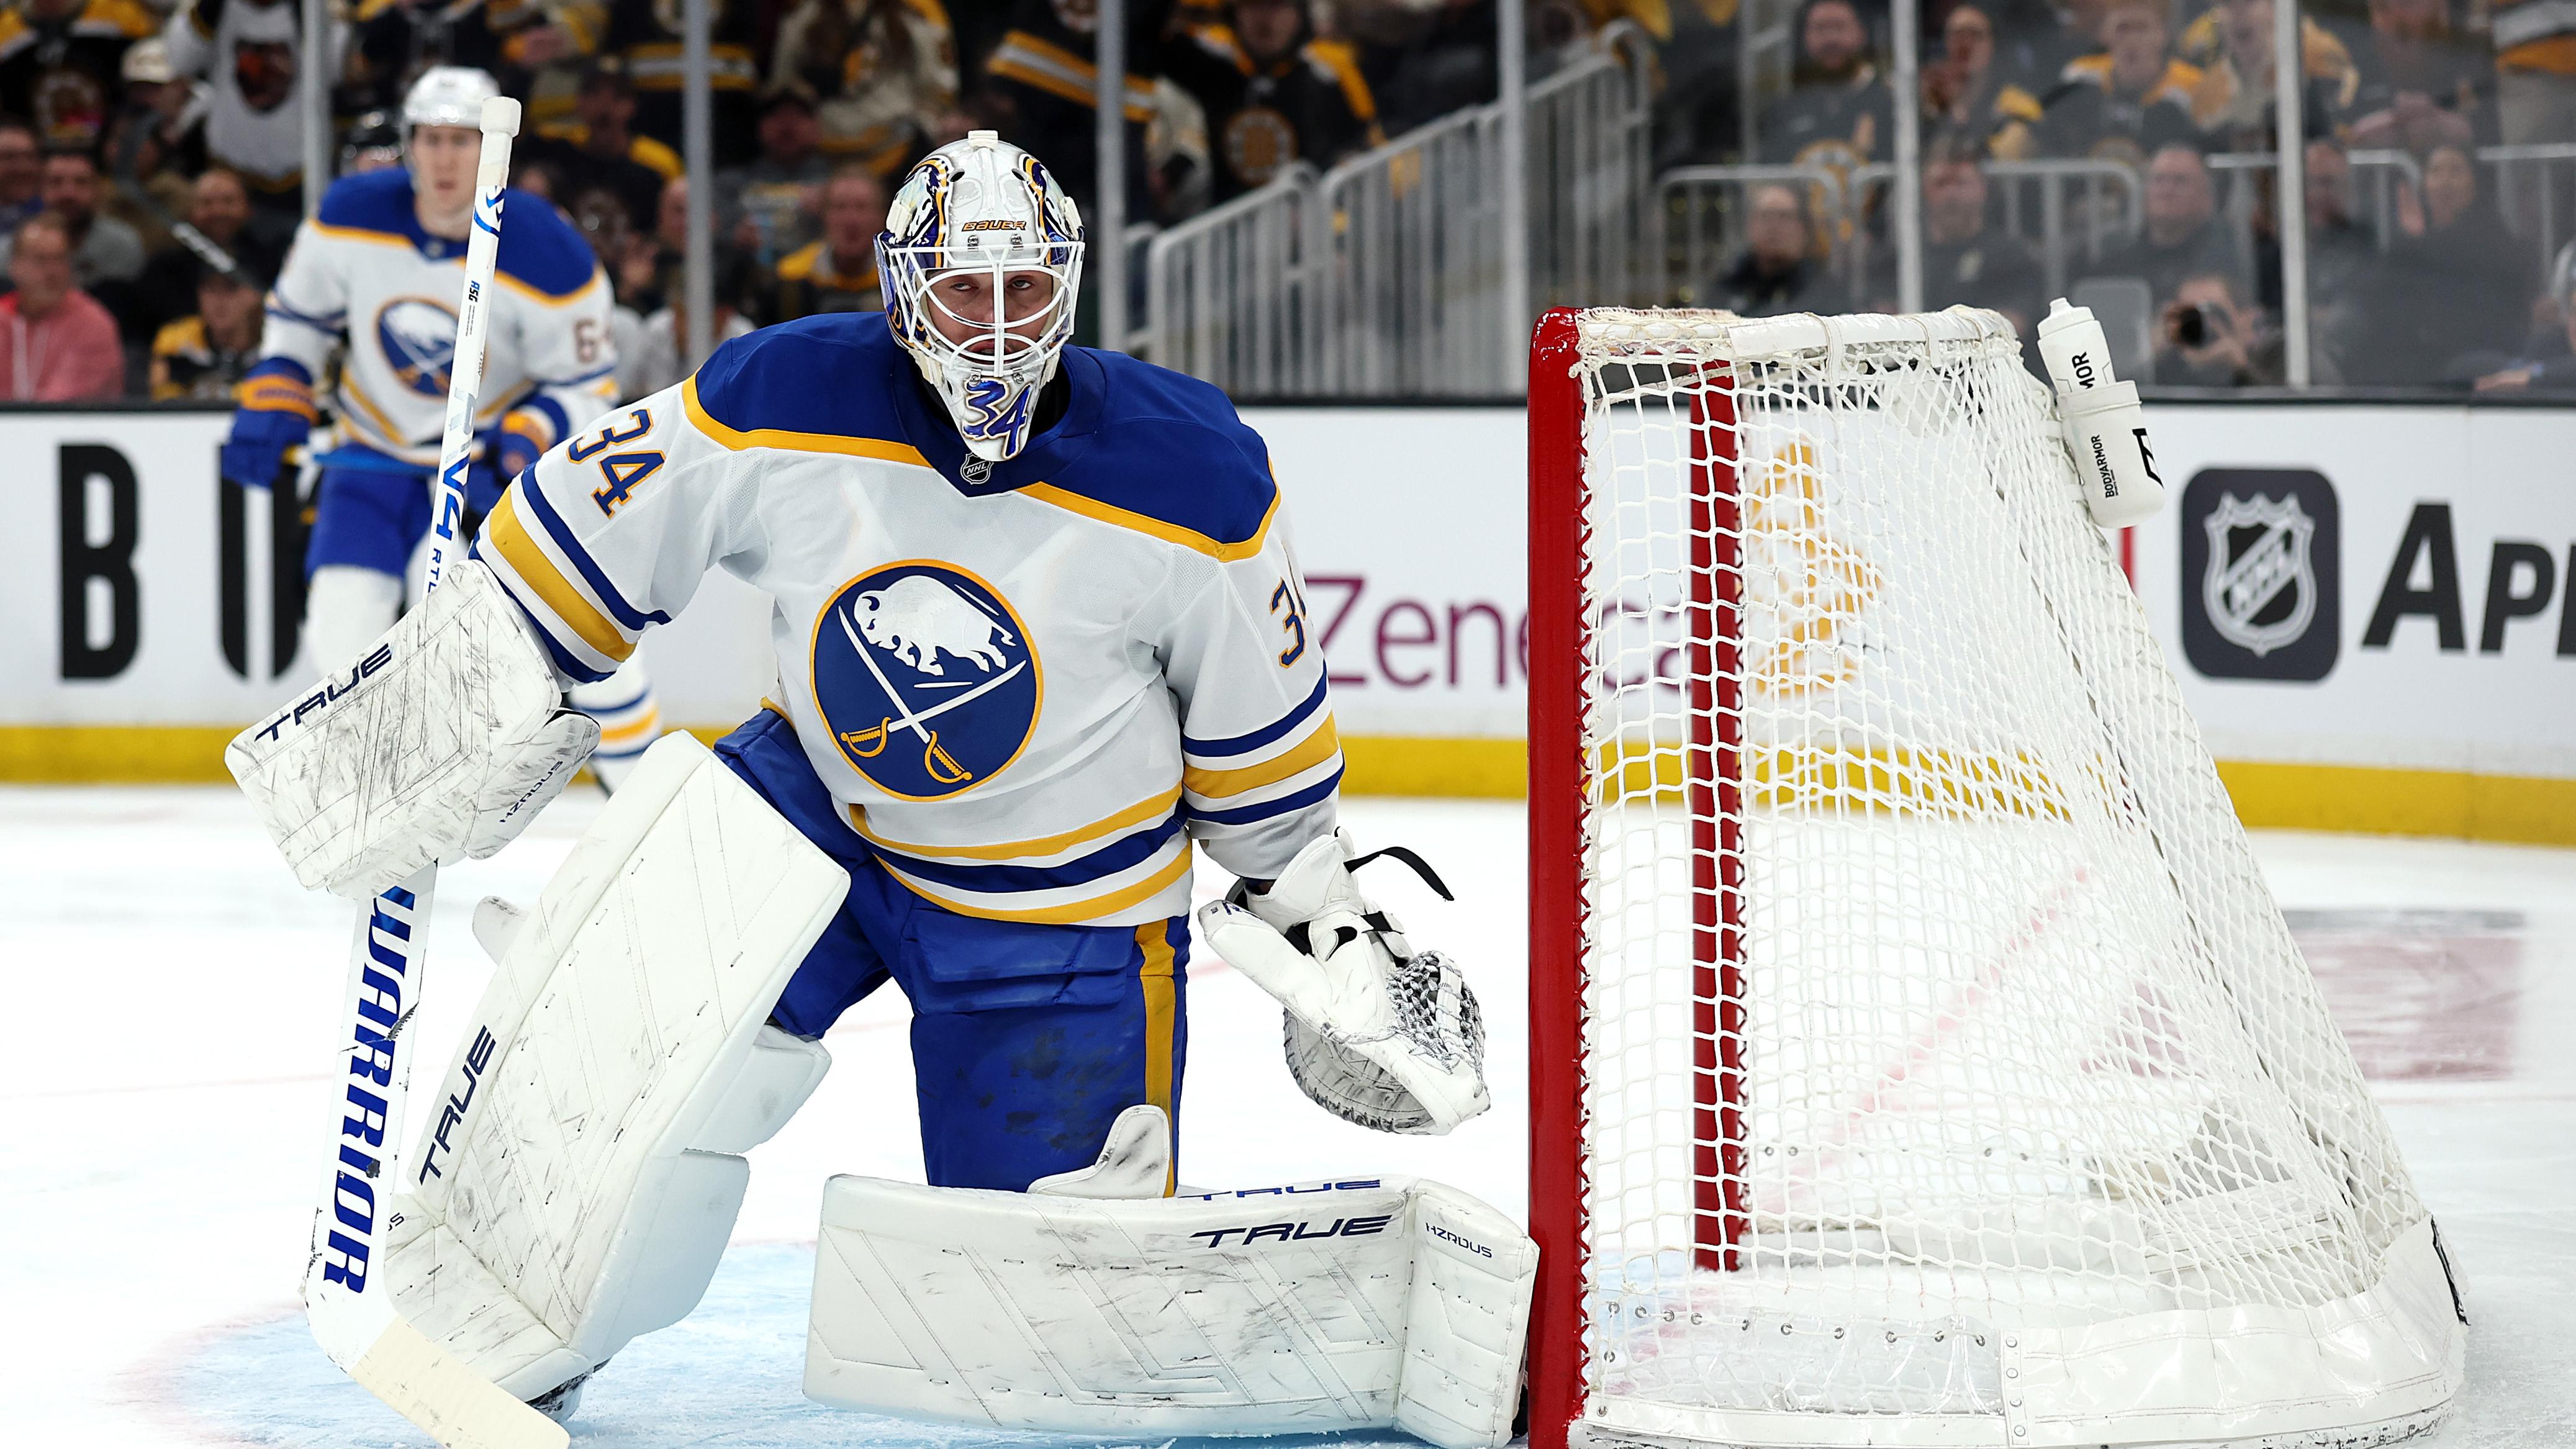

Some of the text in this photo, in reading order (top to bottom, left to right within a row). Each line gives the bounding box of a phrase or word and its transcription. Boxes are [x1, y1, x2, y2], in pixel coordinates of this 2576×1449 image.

[961, 220, 1026, 232] BAUER
[962, 377, 1032, 459] 34
[566, 407, 666, 520] 34
[967, 463, 987, 475] NHL
[2091, 435, 2115, 498] BODYARMOR
[1269, 556, 1308, 669] 3
[255, 643, 392, 742] TRUE
[323, 885, 416, 1293] WARRIOR
[419, 1025, 497, 1186] TRUE
[1178, 1180, 1380, 1201] TRUE
[1190, 1215, 1392, 1248] TRUE
